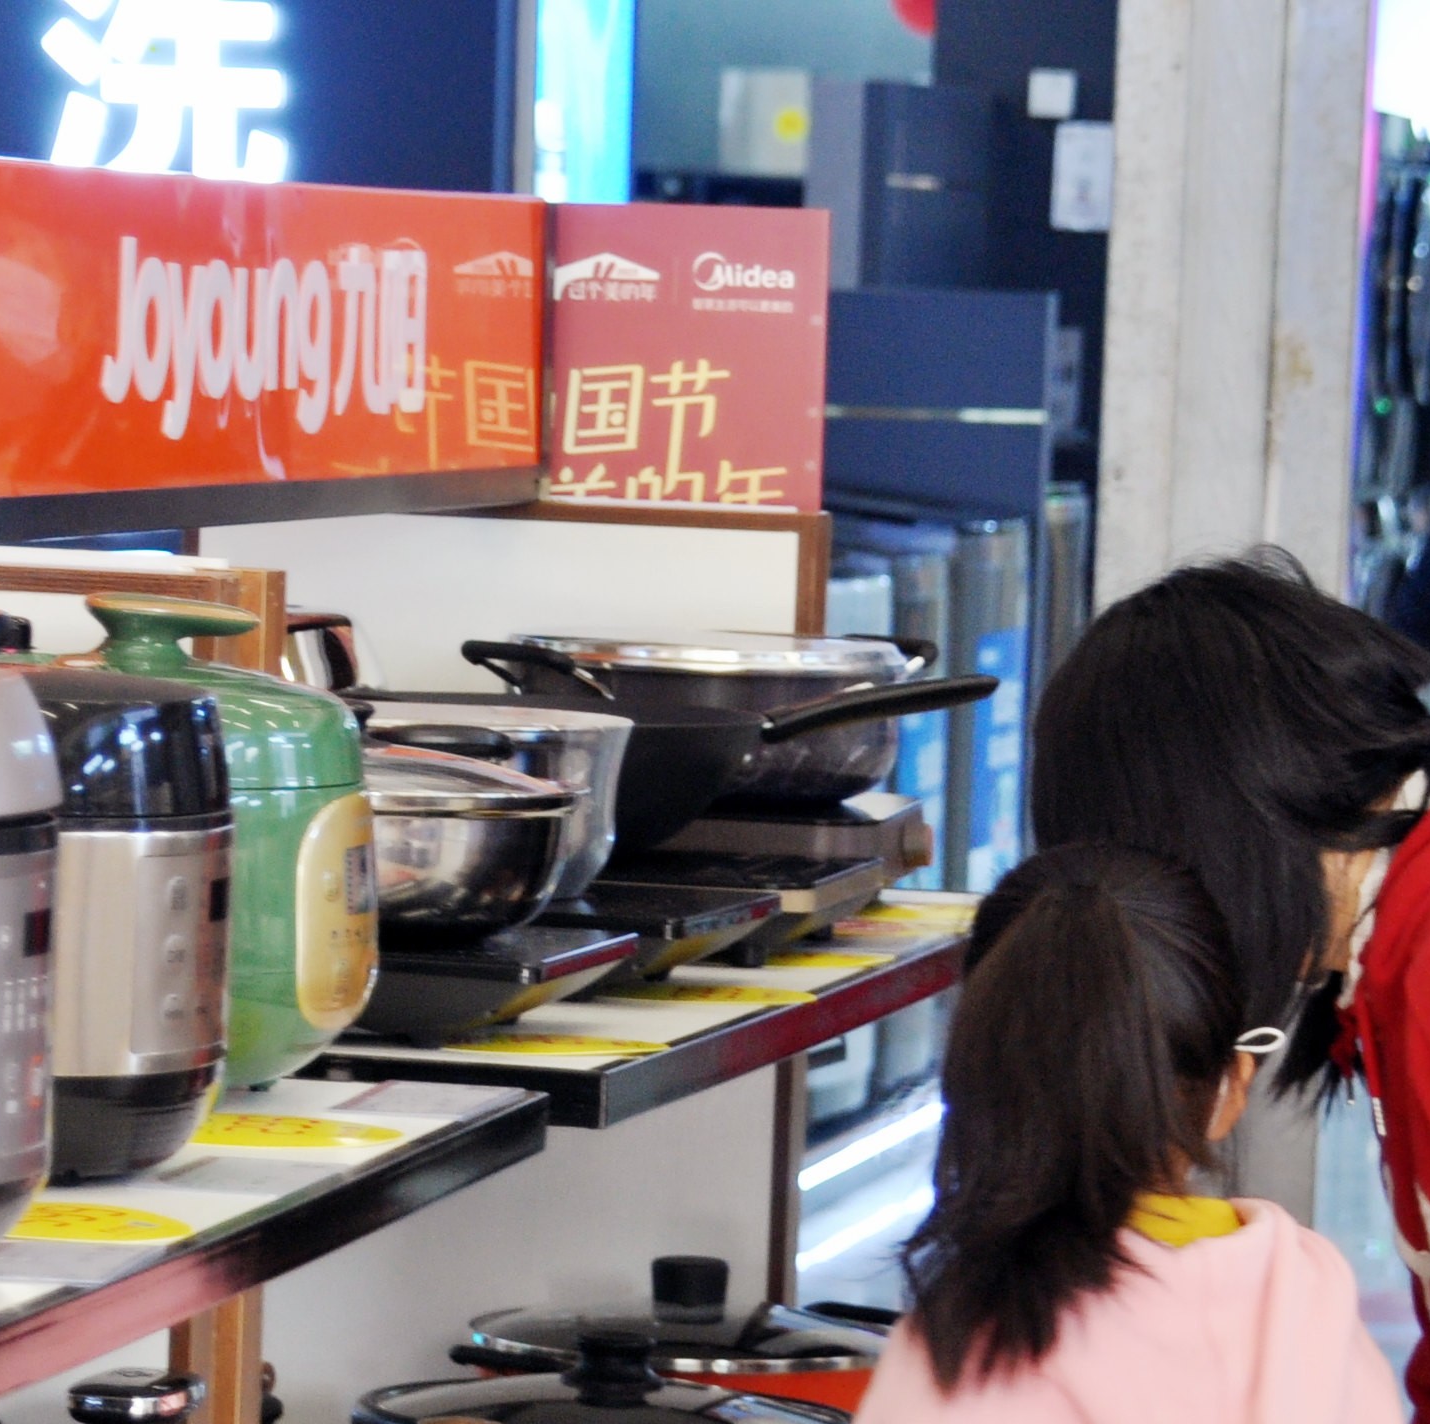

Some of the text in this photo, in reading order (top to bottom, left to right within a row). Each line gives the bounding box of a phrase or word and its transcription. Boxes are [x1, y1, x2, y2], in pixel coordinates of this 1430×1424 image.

[41, 0, 289, 183] 洗
[101, 236, 427, 439] Joyoung 九阳
[692, 251, 796, 292] Midea
[550, 358, 731, 495] 国节
